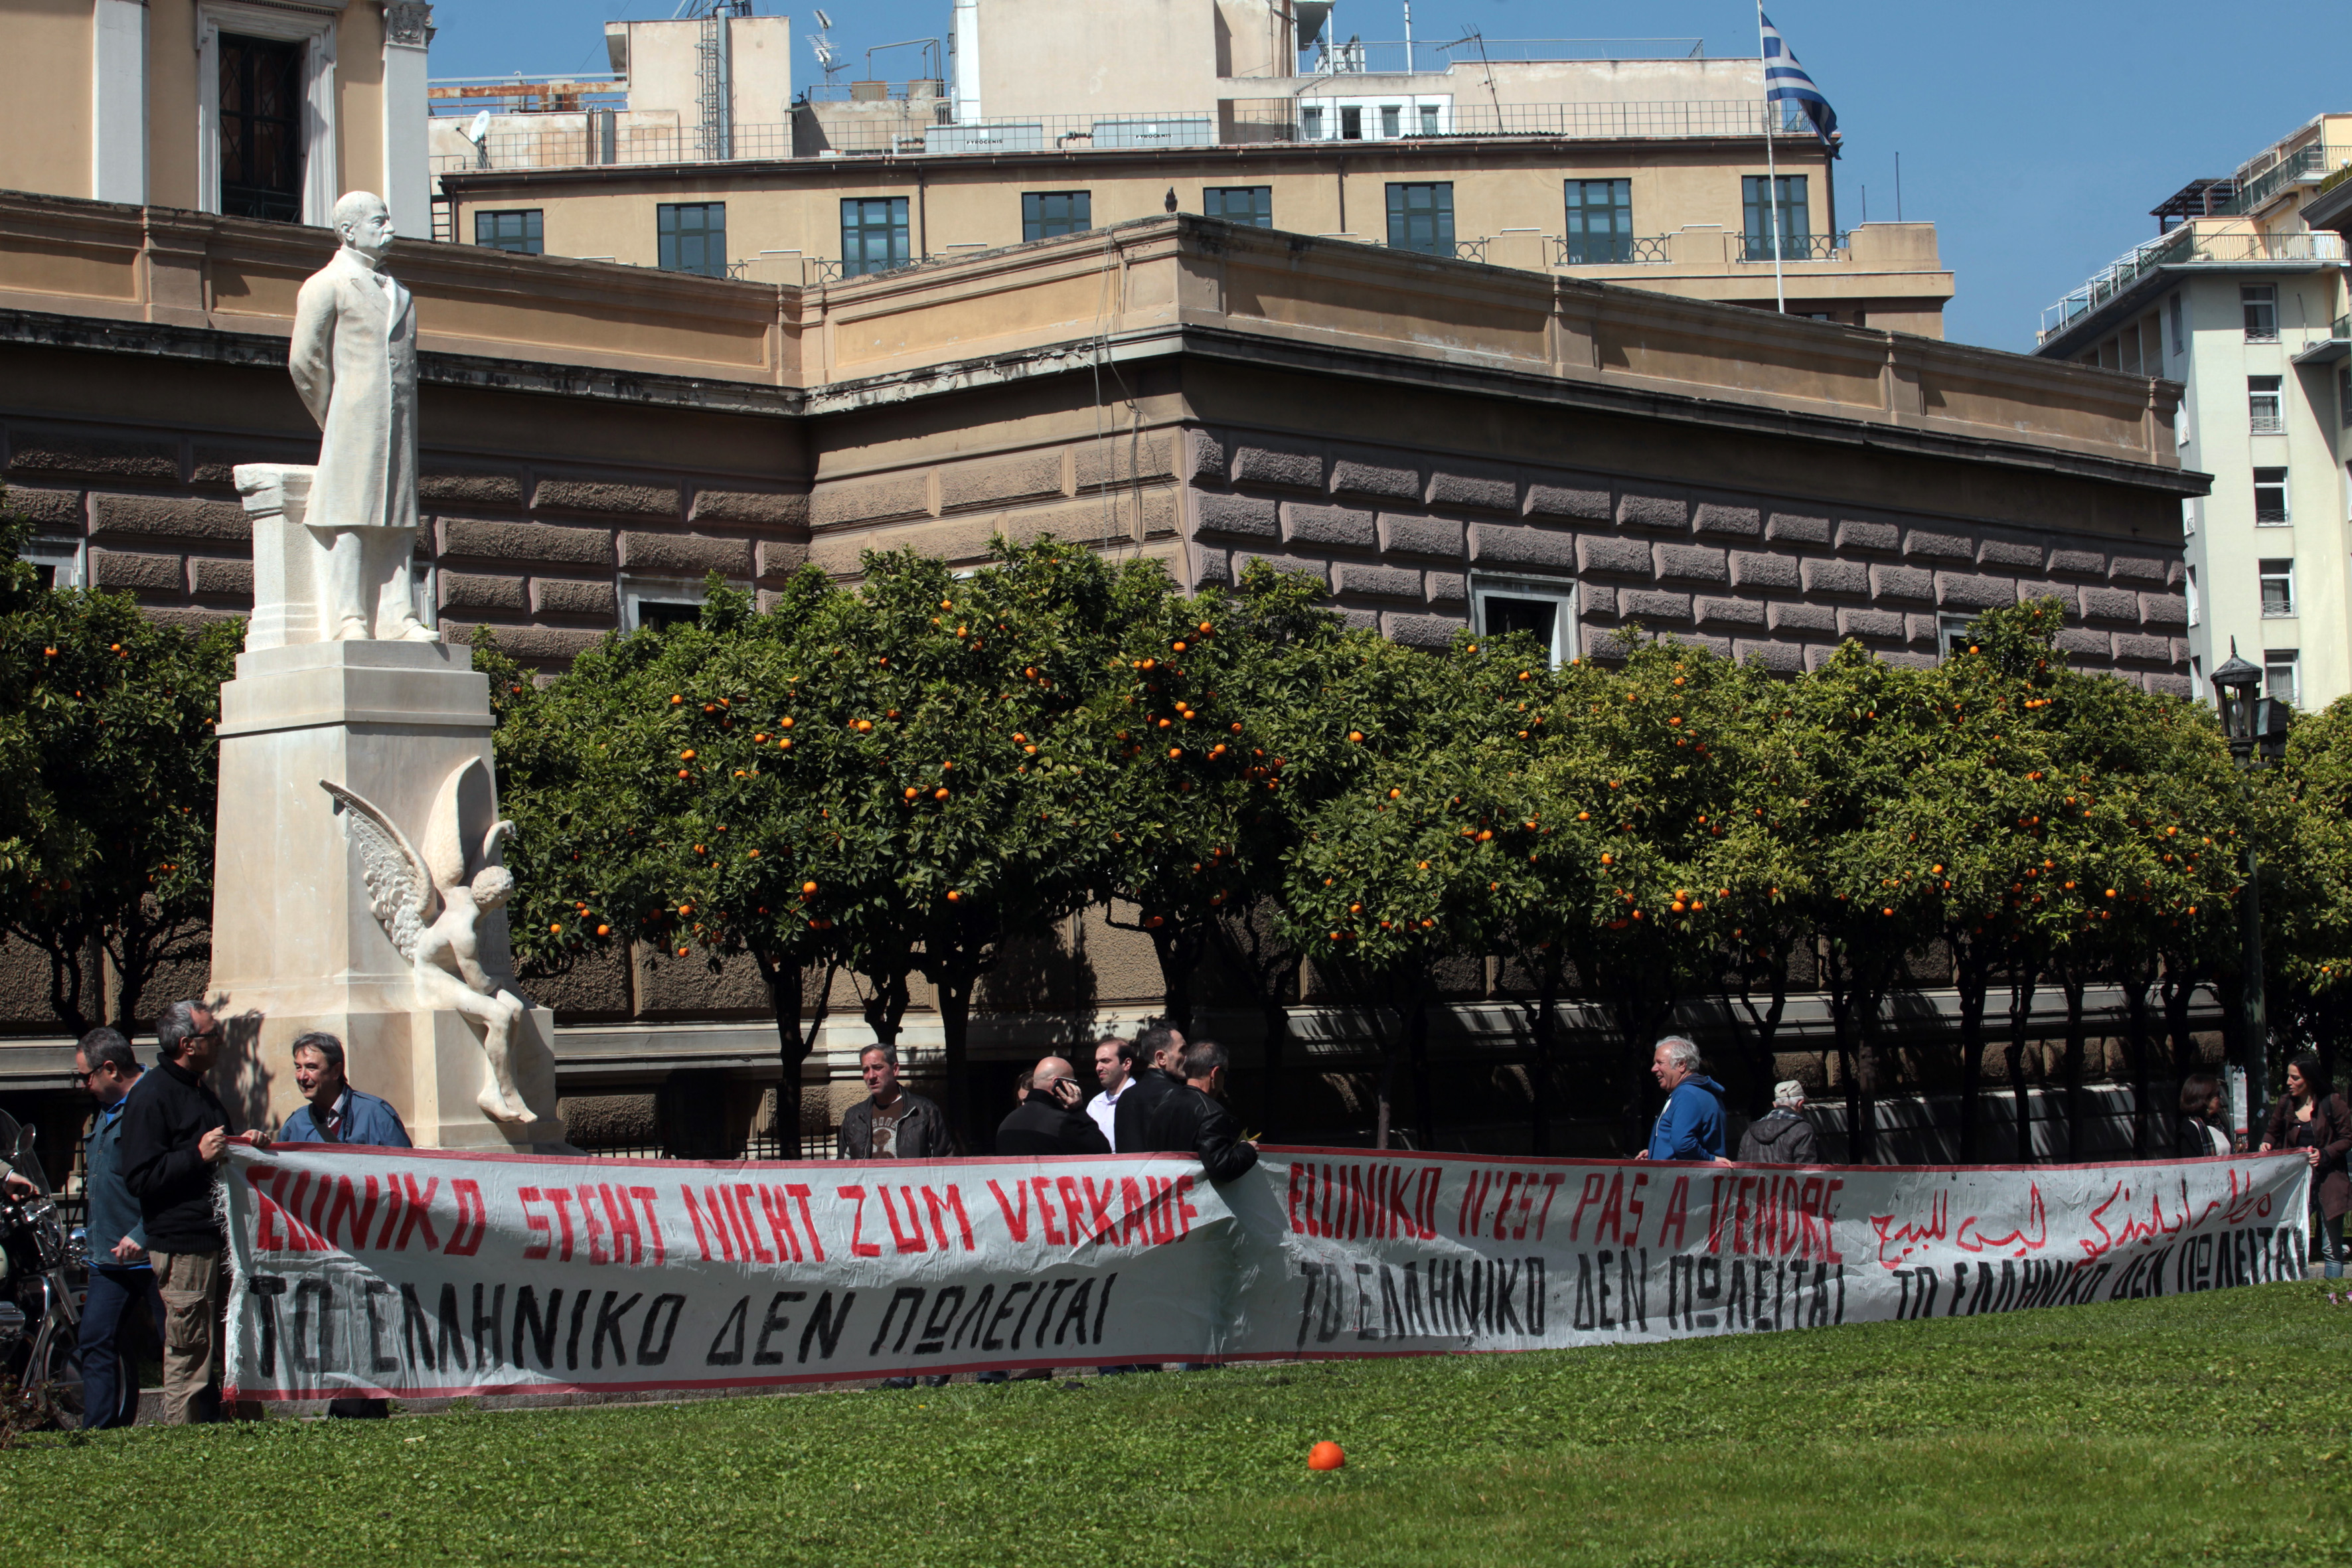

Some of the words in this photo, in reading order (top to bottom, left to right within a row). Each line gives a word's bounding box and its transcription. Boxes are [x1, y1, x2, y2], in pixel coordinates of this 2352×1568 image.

[518, 1182, 664, 1267] STEHT
[680, 1183, 825, 1264] NICHT
[837, 1183, 975, 1257] ZUM
[986, 1175, 1198, 1247] VERKAUF
[1288, 1162, 1443, 1241] ELLINIKO
[1458, 1170, 1566, 1242] N'EST
[1570, 1172, 1649, 1251] PAS
[1658, 1175, 1689, 1250] A
[1708, 1174, 1844, 1264] VENDRE
[706, 1289, 856, 1366] ΔΕΝ
[1573, 1247, 1648, 1333] ΔΕΝ
